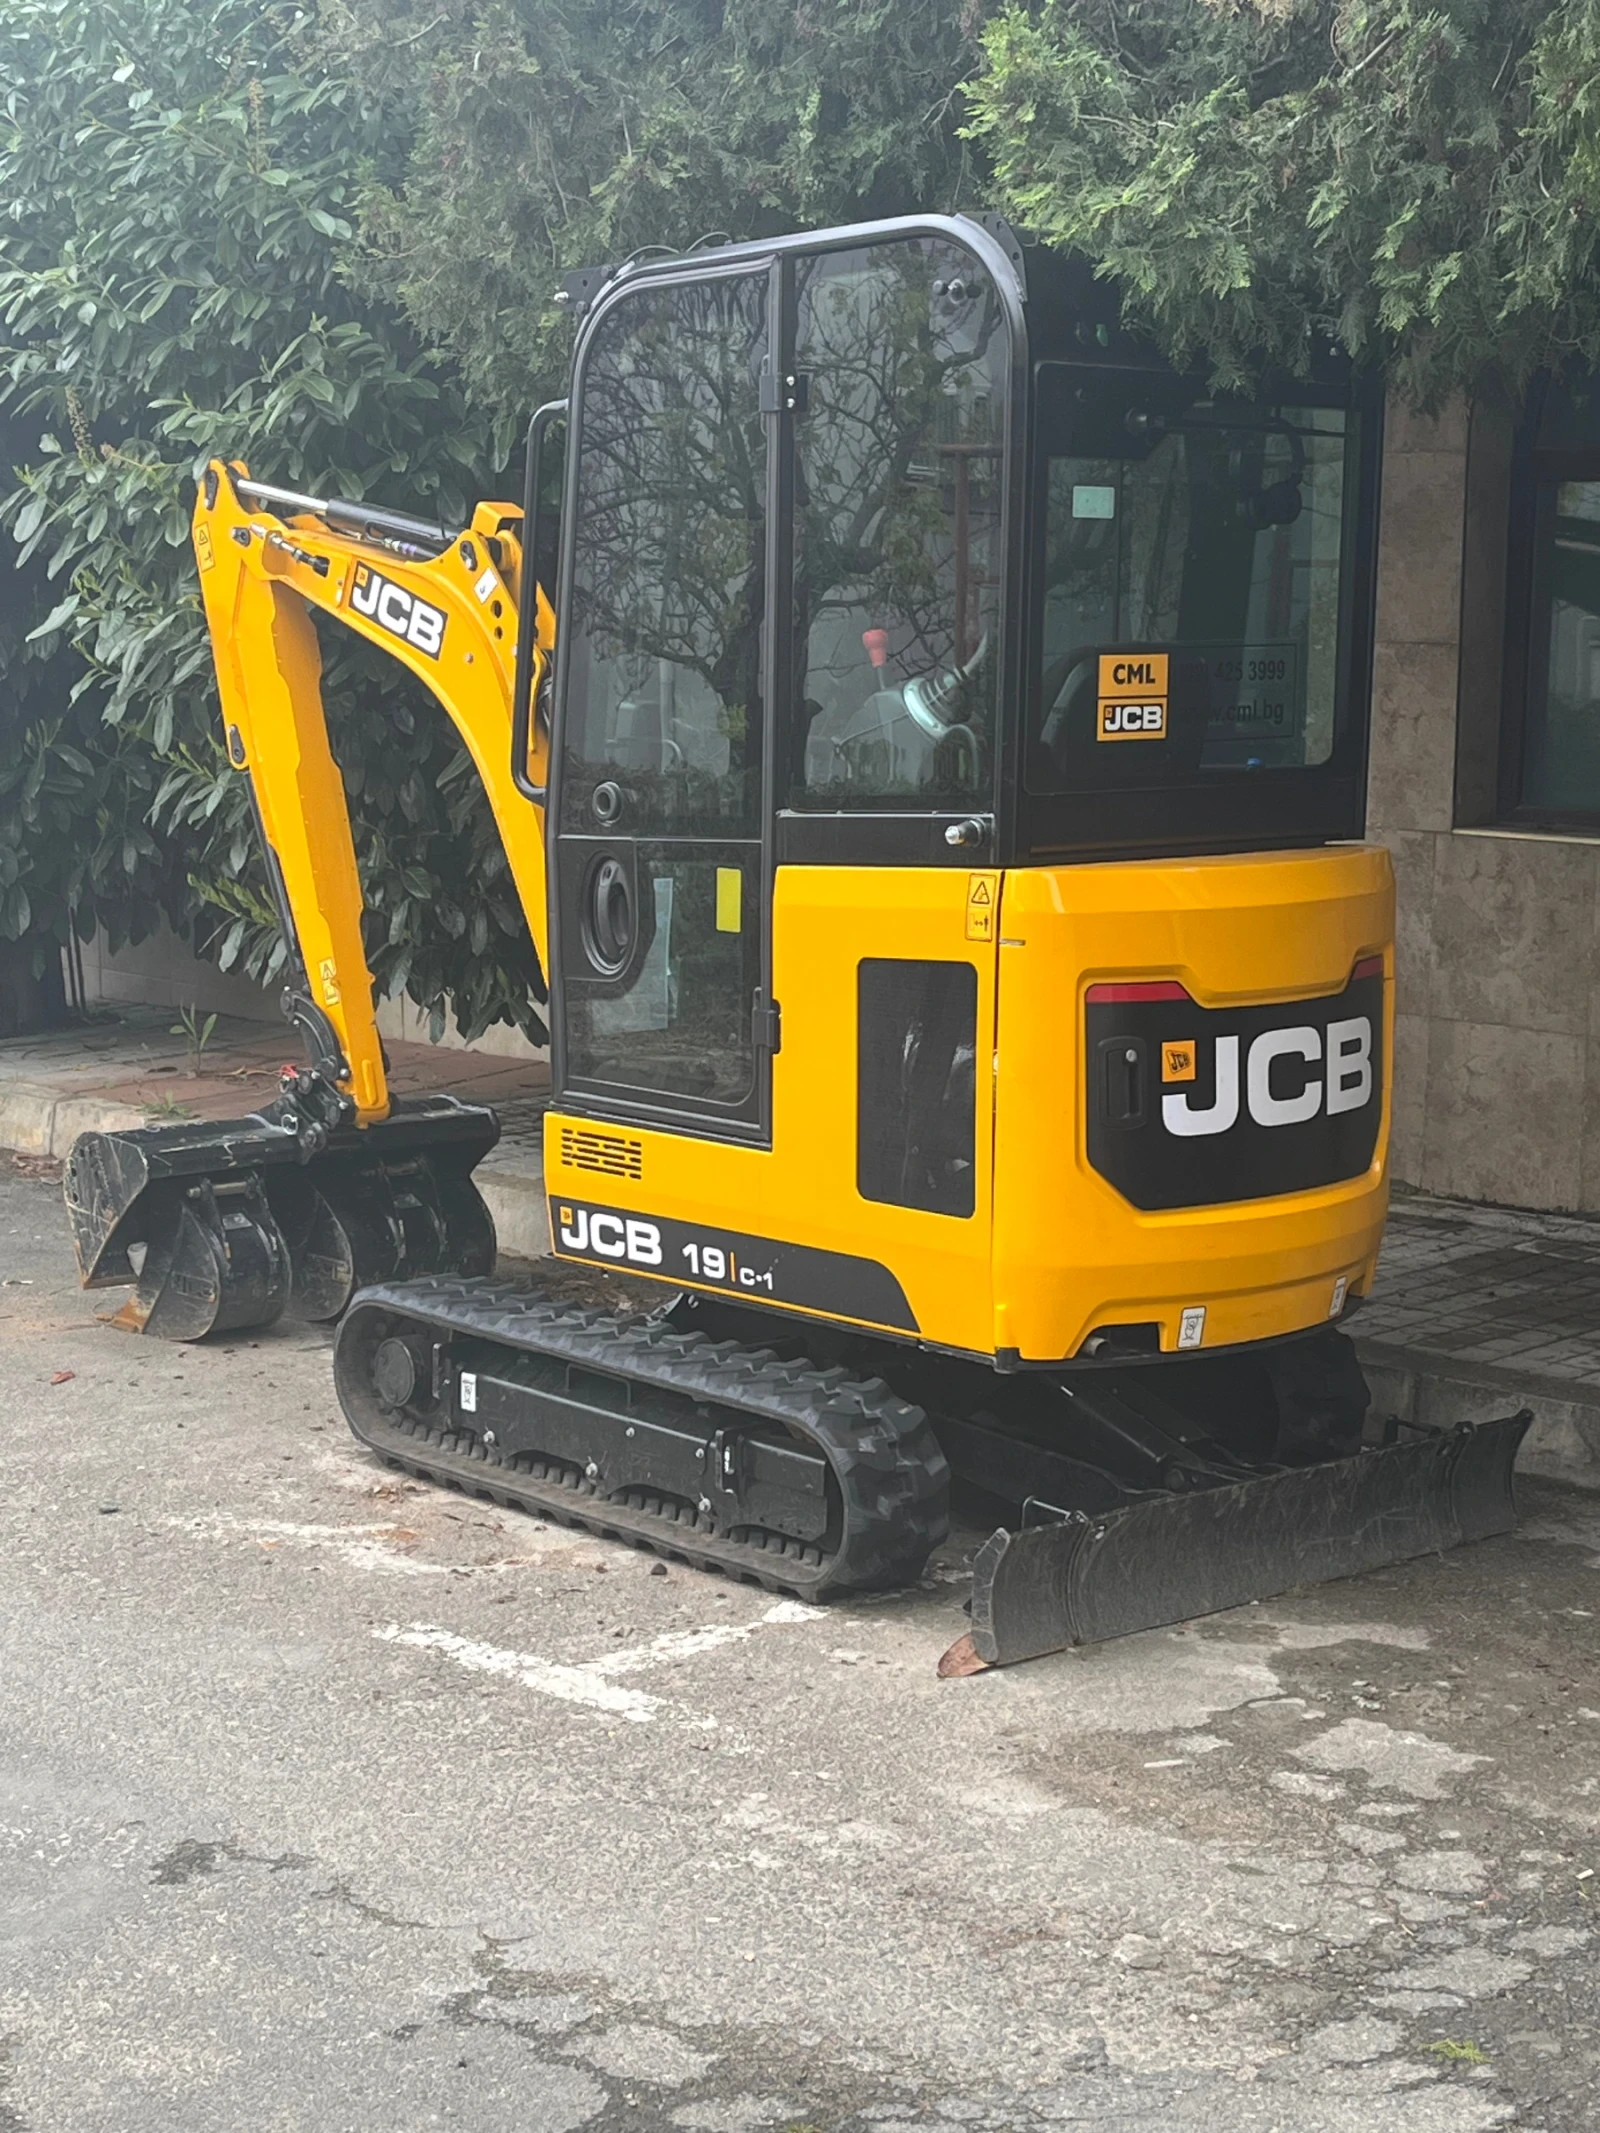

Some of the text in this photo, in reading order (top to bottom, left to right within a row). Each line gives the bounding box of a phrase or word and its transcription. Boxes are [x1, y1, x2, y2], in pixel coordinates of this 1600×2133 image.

[352, 574, 445, 654] JCB
[1112, 662, 1156, 686] CML
[1247, 659, 1286, 681] 3999
[1104, 705, 1163, 732] JCB
[1162, 1016, 1372, 1136] JCB
[561, 1209, 663, 1265] JCB
